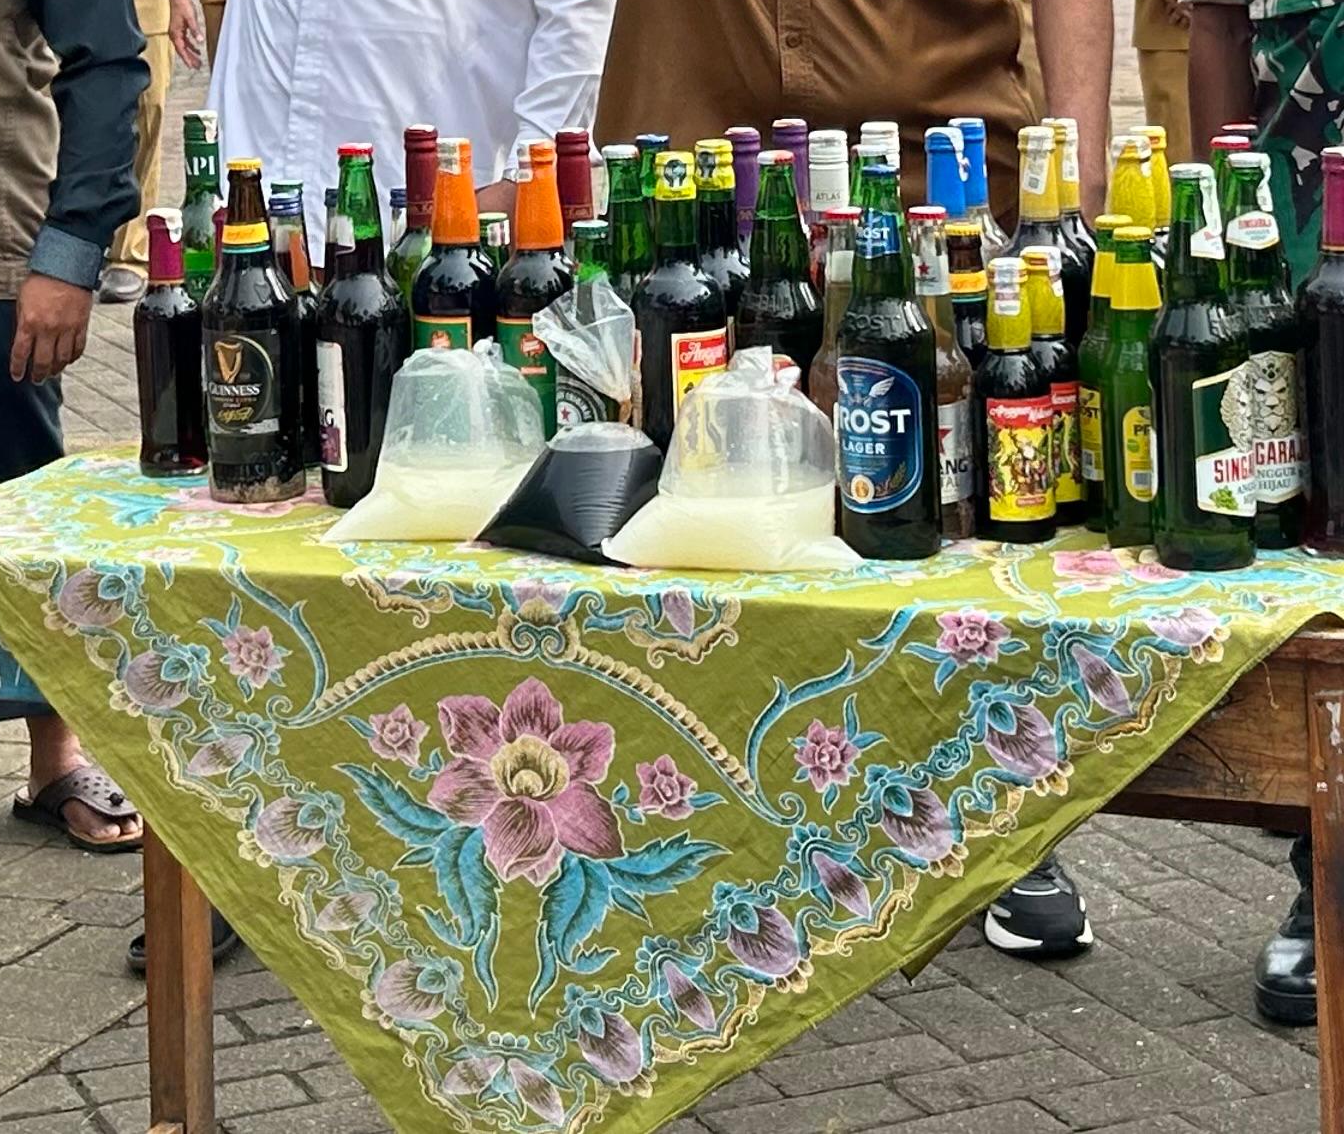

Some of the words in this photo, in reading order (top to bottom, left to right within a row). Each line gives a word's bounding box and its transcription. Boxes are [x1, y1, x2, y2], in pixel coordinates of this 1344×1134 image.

[815, 192, 842, 202] ATLAS
[208, 381, 263, 396] GUINNESS
[838, 407, 912, 435] ROST
[842, 441, 886, 456] LAGER
